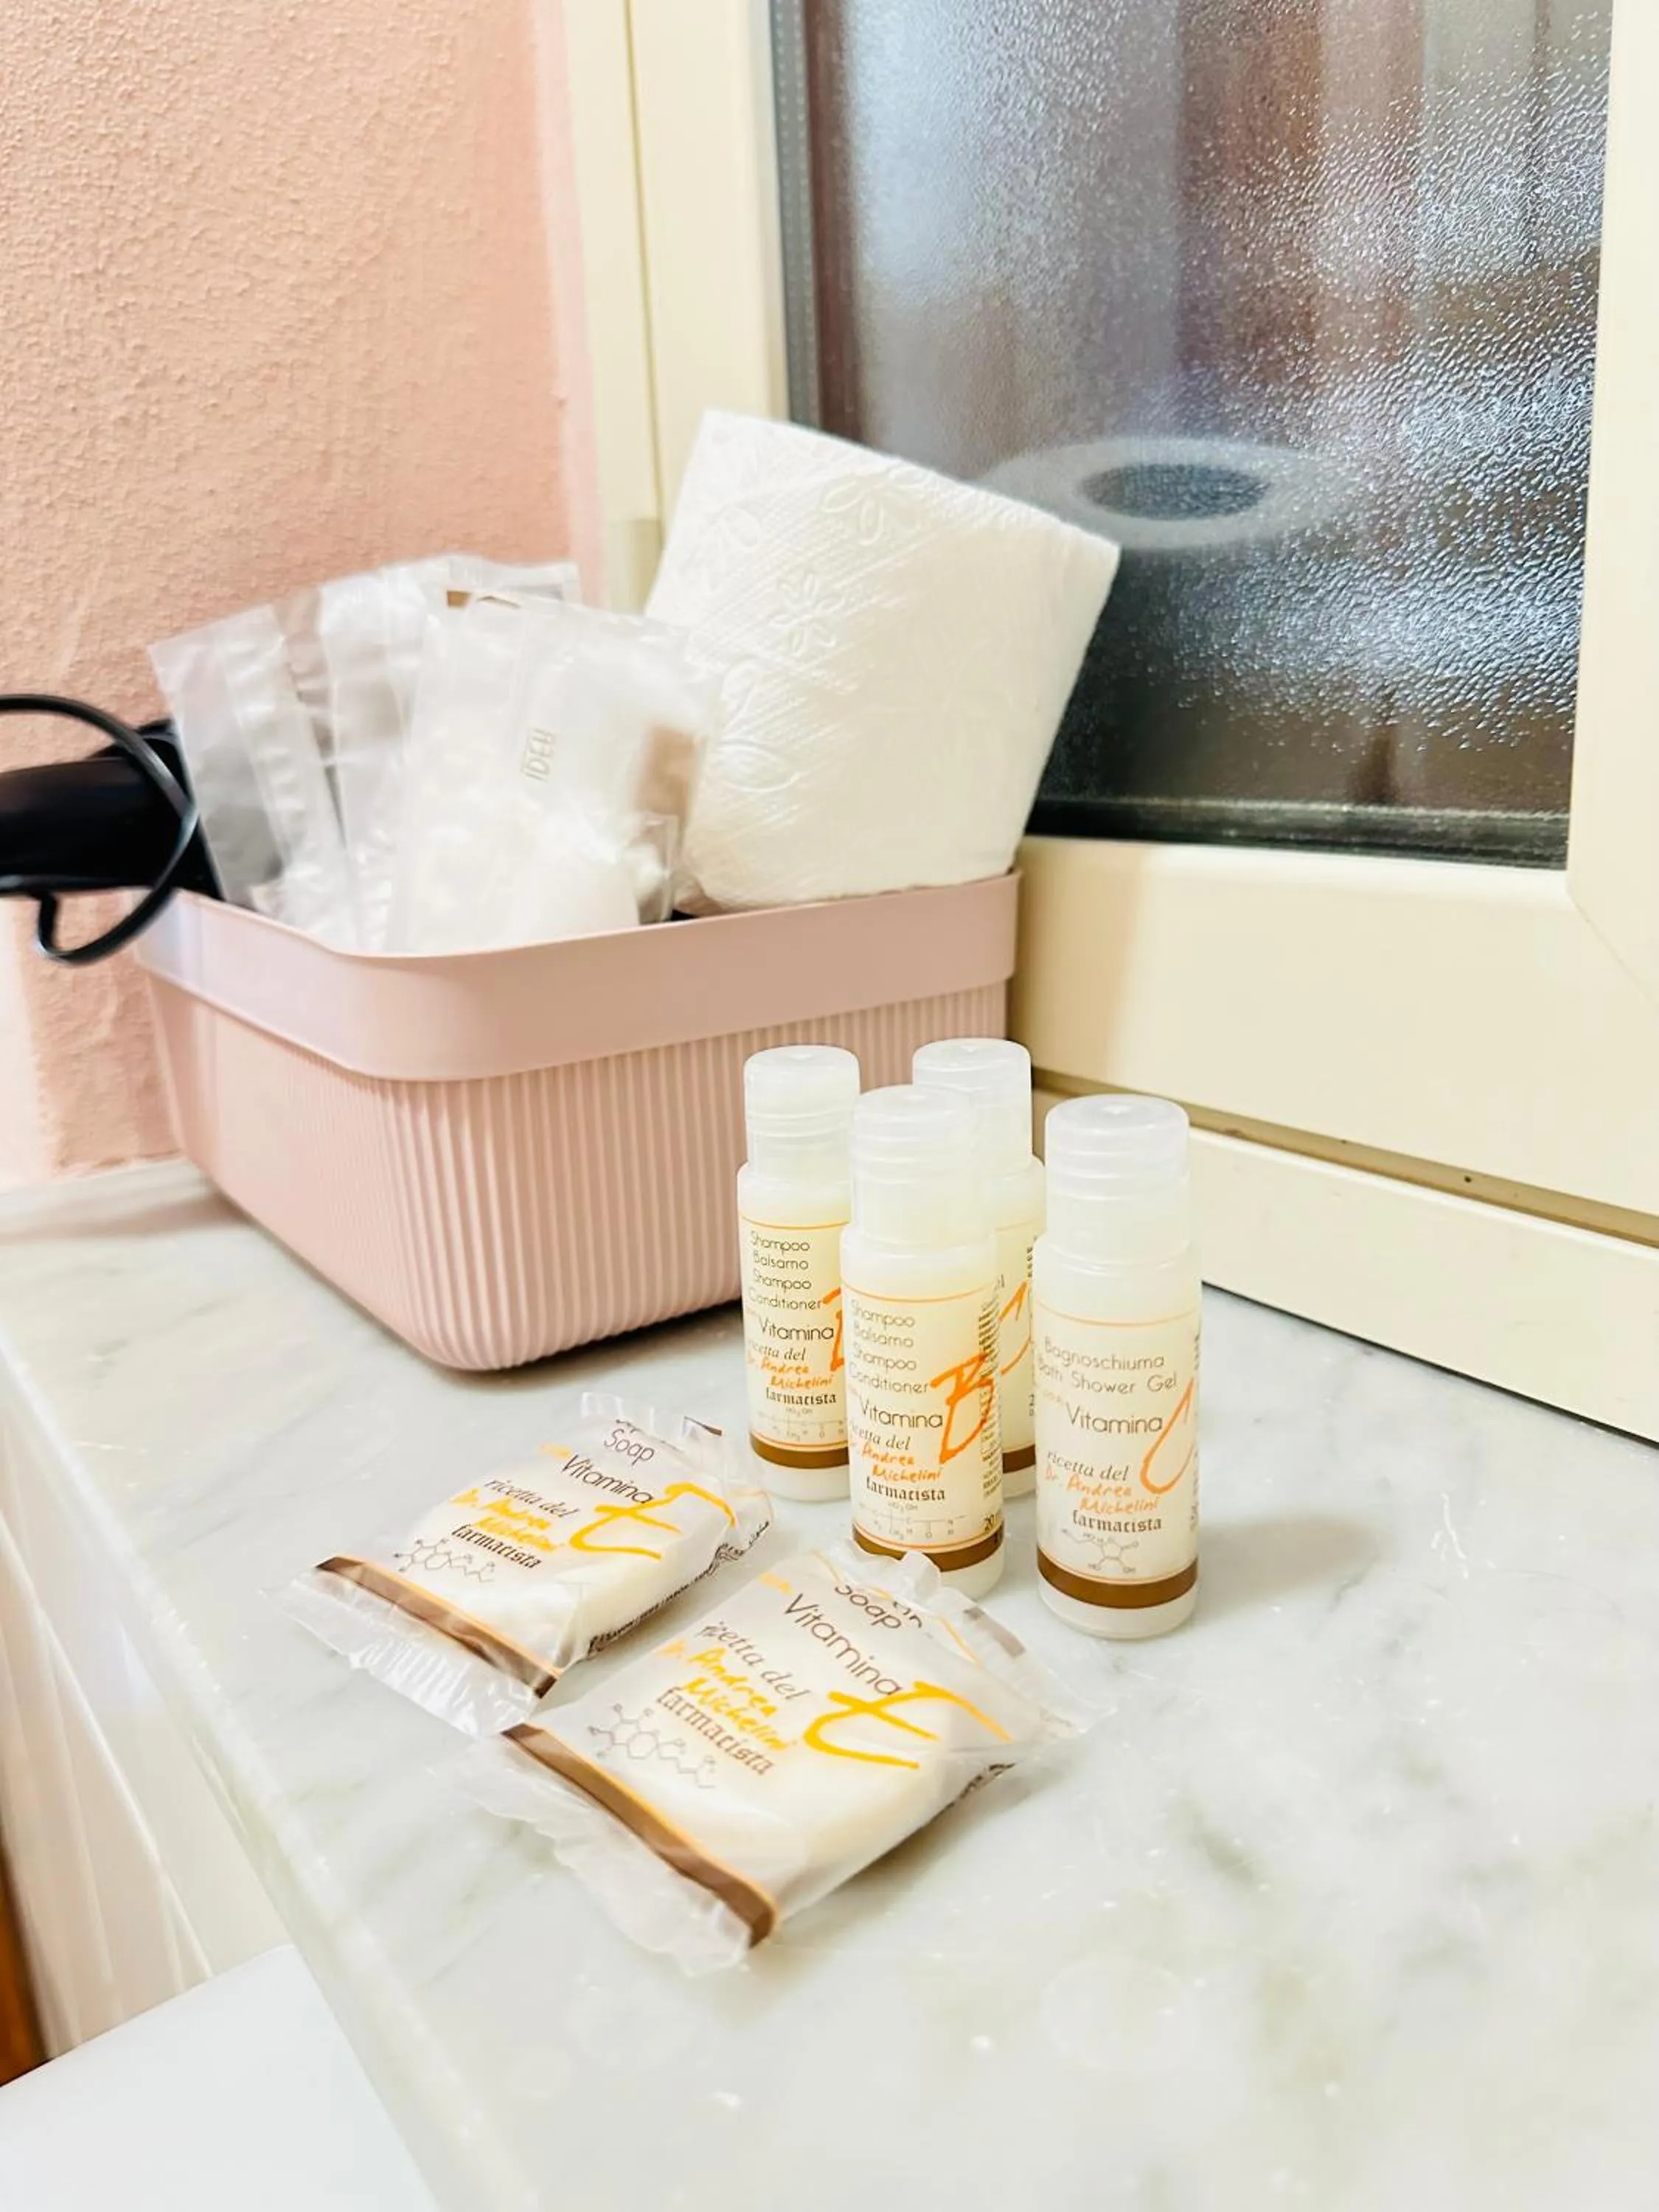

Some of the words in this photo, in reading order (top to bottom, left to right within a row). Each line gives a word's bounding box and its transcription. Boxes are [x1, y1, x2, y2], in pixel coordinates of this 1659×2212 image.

[750, 1230, 810, 1259] Shampoo
[754, 1251, 809, 1270] Balsamo
[753, 1267, 812, 1293] Shampoo
[748, 1287, 822, 1310] Conditioner
[759, 1316, 834, 1340] Vitamina
[852, 1299, 915, 1330] Shampoo
[854, 1320, 914, 1348] Balsamo
[784, 1347, 807, 1361] del
[853, 1342, 917, 1374] Shampoo
[1045, 1336, 1165, 1371] Bagnoschiuma
[849, 1361, 929, 1394] Conditioner
[1071, 1370, 1135, 1394] Shower
[1147, 1372, 1179, 1392] Gel
[766, 1387, 837, 1405] farmacista
[859, 1397, 943, 1428] Vitamina
[1065, 1401, 1163, 1435] Vitamina
[604, 1428, 655, 1466] Soap
[886, 1433, 911, 1450] del
[561, 1453, 654, 1503] Vitamina
[1047, 1450, 1093, 1477] ricetta
[1099, 1464, 1130, 1481] del
[866, 1476, 945, 1501] farmacista
[1073, 1510, 1162, 1533] farmacista
[451, 1523, 543, 1569] farmacista
[785, 1593, 904, 1697] Vitamina
[759, 1670, 811, 1700] del
[656, 1686, 774, 1775] farmacista
